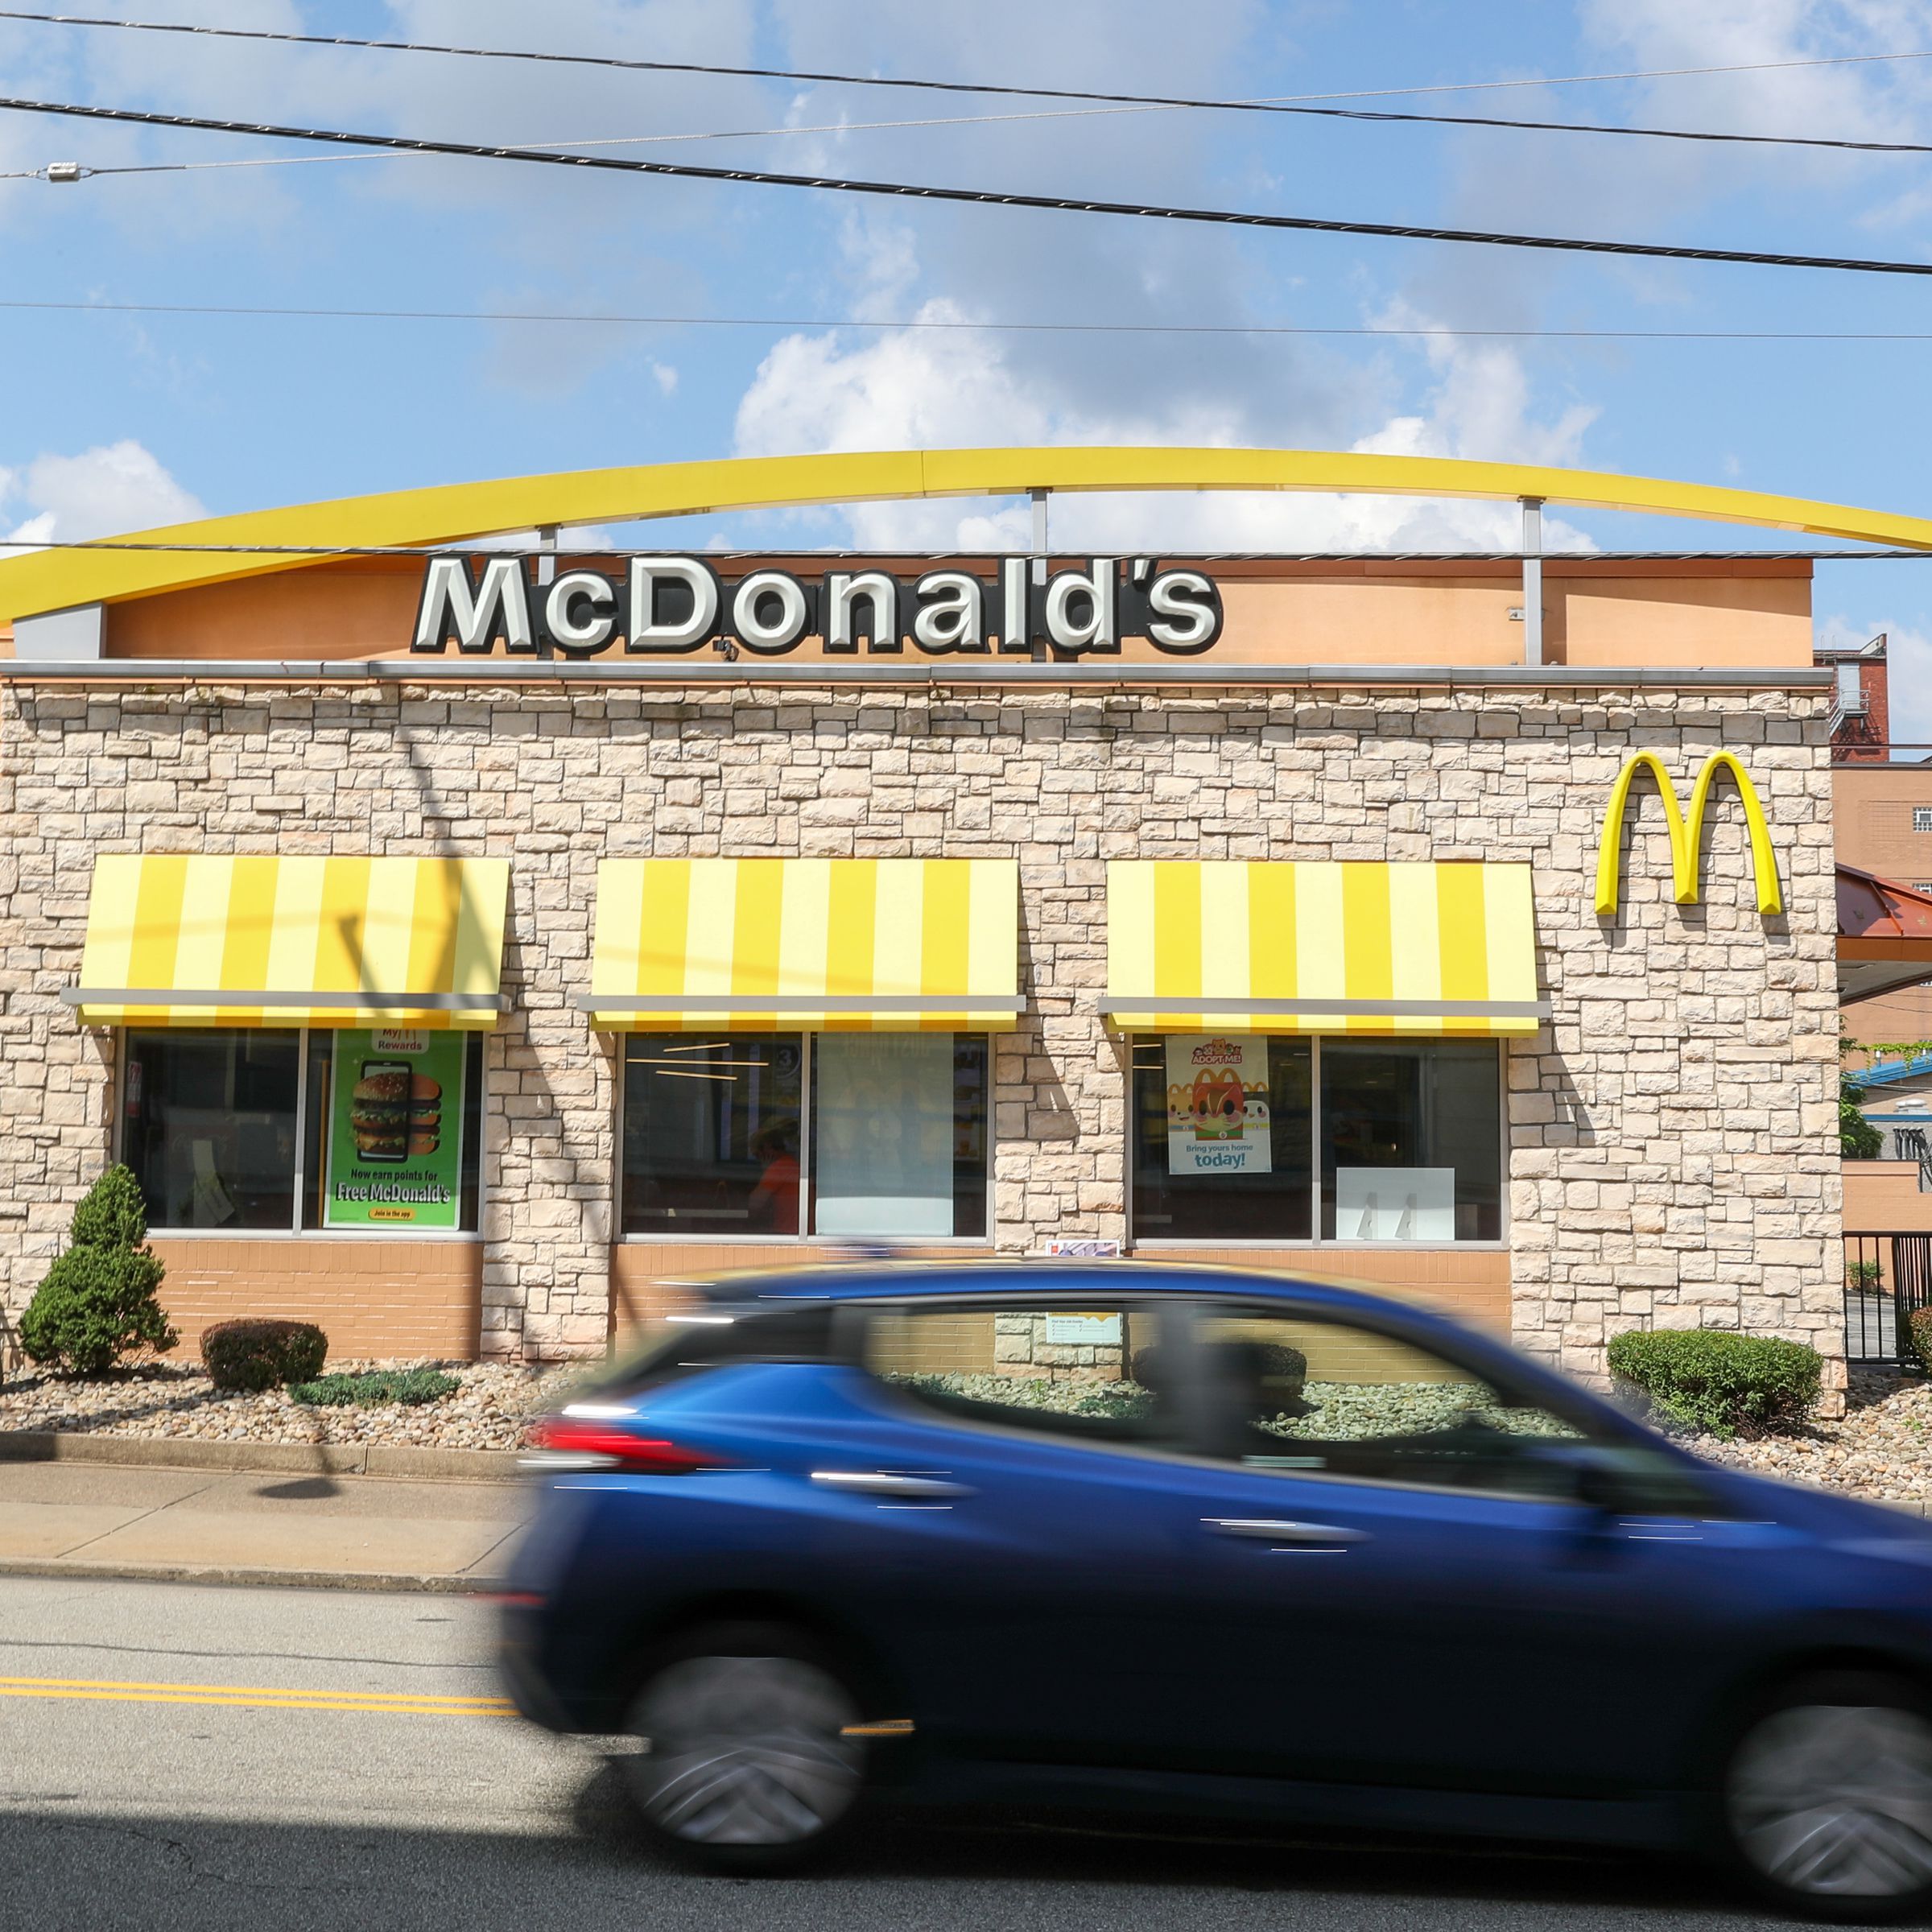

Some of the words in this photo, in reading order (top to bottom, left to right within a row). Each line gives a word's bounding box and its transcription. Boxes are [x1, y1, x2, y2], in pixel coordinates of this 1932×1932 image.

[414, 555, 1220, 650] McDonald's
[378, 1040, 422, 1050] Rewards
[1191, 1055, 1224, 1064] ADOPT
[1224, 1055, 1242, 1064] ME!
[1186, 1145, 1208, 1153] Bring
[1195, 1153, 1246, 1169] today!
[351, 1169, 370, 1179] Now
[372, 1171, 392, 1180] earn
[394, 1170, 422, 1183] points
[424, 1170, 438, 1181] for
[336, 1182, 367, 1202] Free
[368, 1183, 451, 1204] McDonald's
